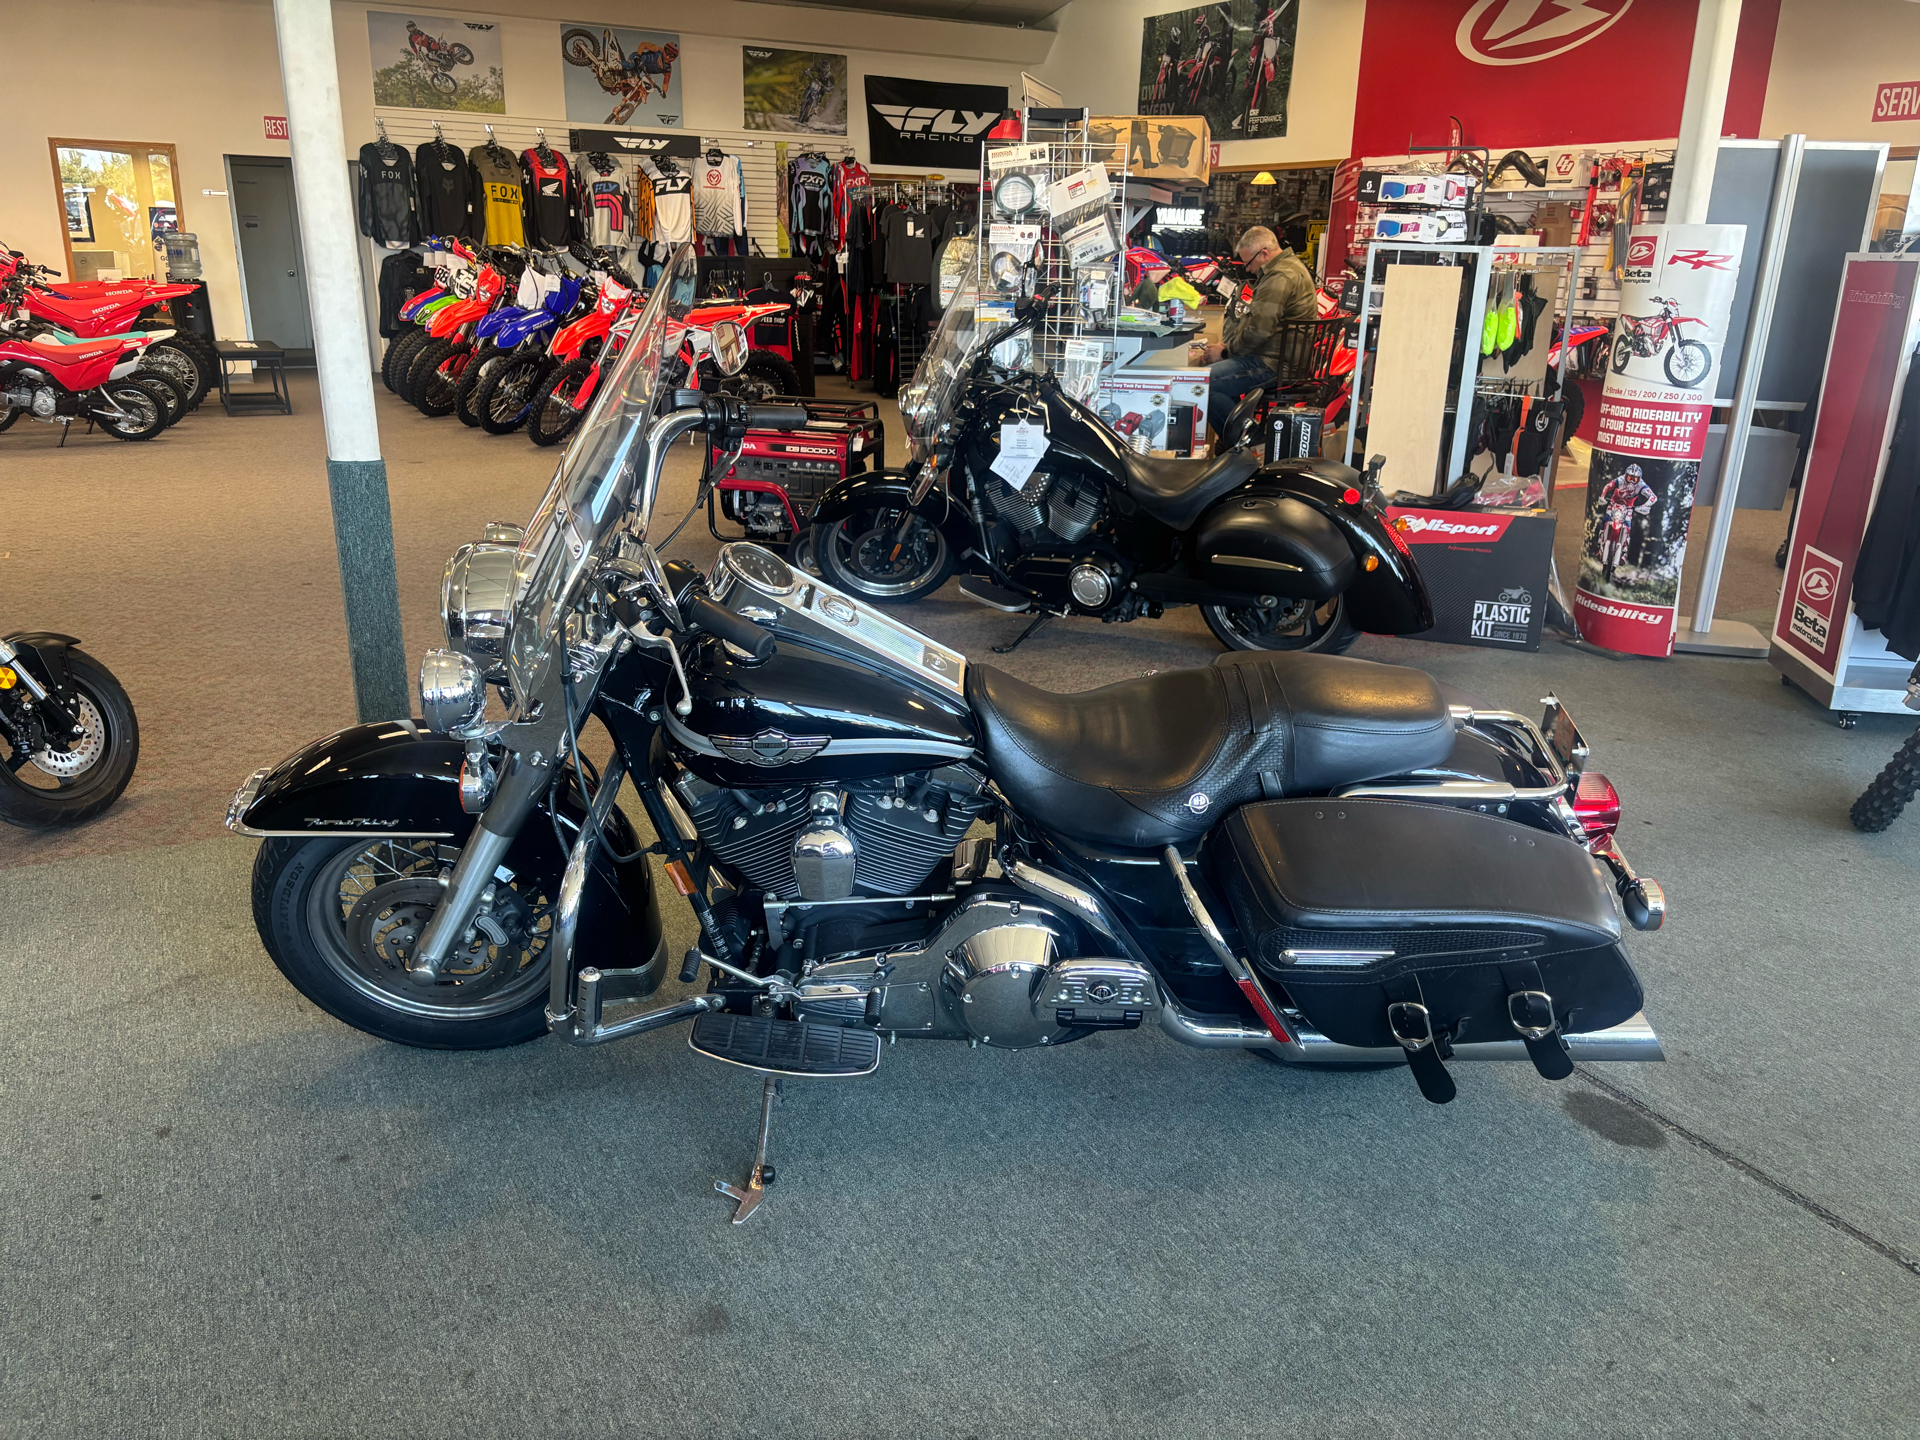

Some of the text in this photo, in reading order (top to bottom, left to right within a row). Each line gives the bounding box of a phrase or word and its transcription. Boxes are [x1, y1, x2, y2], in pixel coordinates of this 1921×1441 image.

[871, 103, 1001, 136] FLY
[1249, 113, 1283, 125] PERFORMANCE
[613, 137, 671, 151] FLY
[900, 132, 974, 143] RACING
[381, 170, 401, 180] FOX
[800, 174, 825, 184] FXR
[846, 176, 866, 187] FXR
[491, 185, 518, 200] FOX
[595, 183, 618, 194] FLY
[655, 178, 688, 194] FLY
[1624, 269, 1652, 278] Beta
[1848, 289, 1905, 309] Rideability
[92, 302, 120, 314] HONDA
[78, 350, 103, 359] HONDA
[1643, 391, 1656, 399] 200
[1664, 392, 1679, 400] 250
[1601, 403, 1702, 424] OFF-ROAD RIDEABILITY
[1606, 419, 1624, 432] FOUR
[1625, 421, 1653, 435] SIZES
[1655, 424, 1671, 437] TO
[1673, 425, 1693, 438] FIT
[1597, 431, 1691, 453] MOST RIDER'S NEEDS
[800, 446, 836, 455] 5000X
[1399, 515, 1499, 536] Plisport
[1473, 603, 1531, 624] PLASTIC
[1575, 594, 1664, 625] Rideability
[1471, 619, 1494, 637] KIT
[1493, 630, 1510, 639] SINCE
[1512, 632, 1527, 640] 1978
[1794, 606, 1826, 639] Beta
[1792, 623, 1825, 648] motorcycles
[279, 862, 305, 931] DAVIDSON
